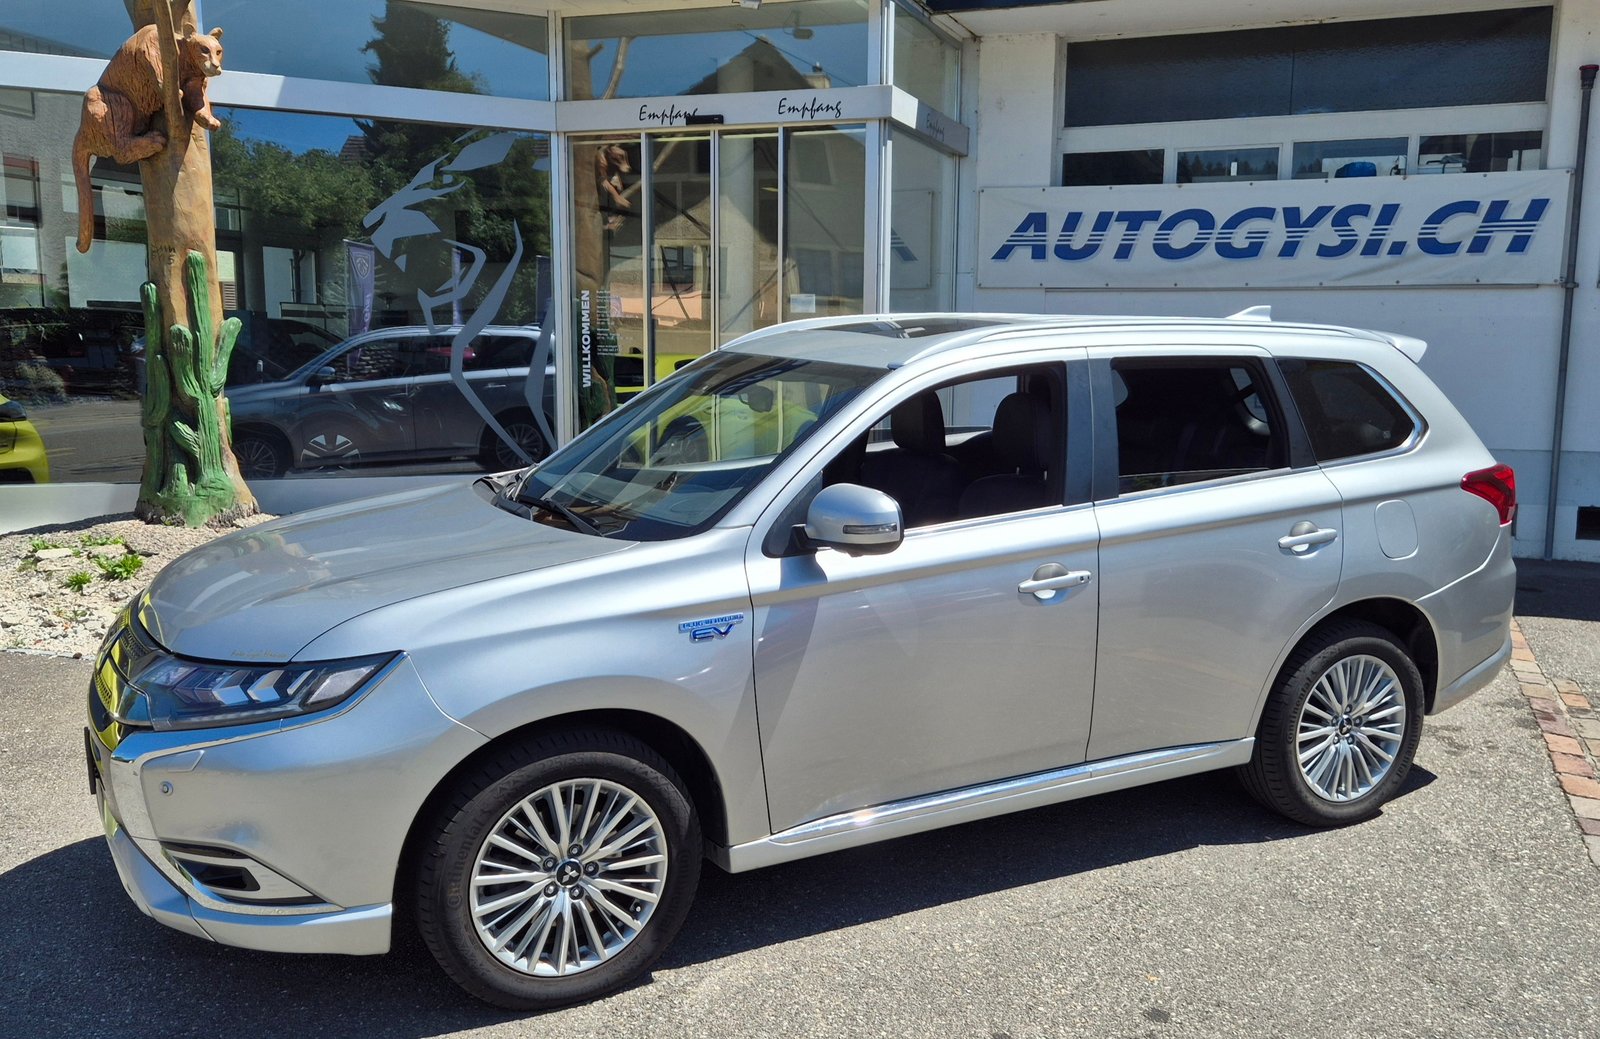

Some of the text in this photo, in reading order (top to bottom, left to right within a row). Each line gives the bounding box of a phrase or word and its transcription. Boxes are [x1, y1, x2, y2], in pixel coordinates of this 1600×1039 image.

[778, 97, 842, 119] Empfang
[990, 198, 1551, 262] AUTOGYSI.CH
[581, 289, 591, 388] WILLKOMMEN
[690, 623, 736, 642] EV
